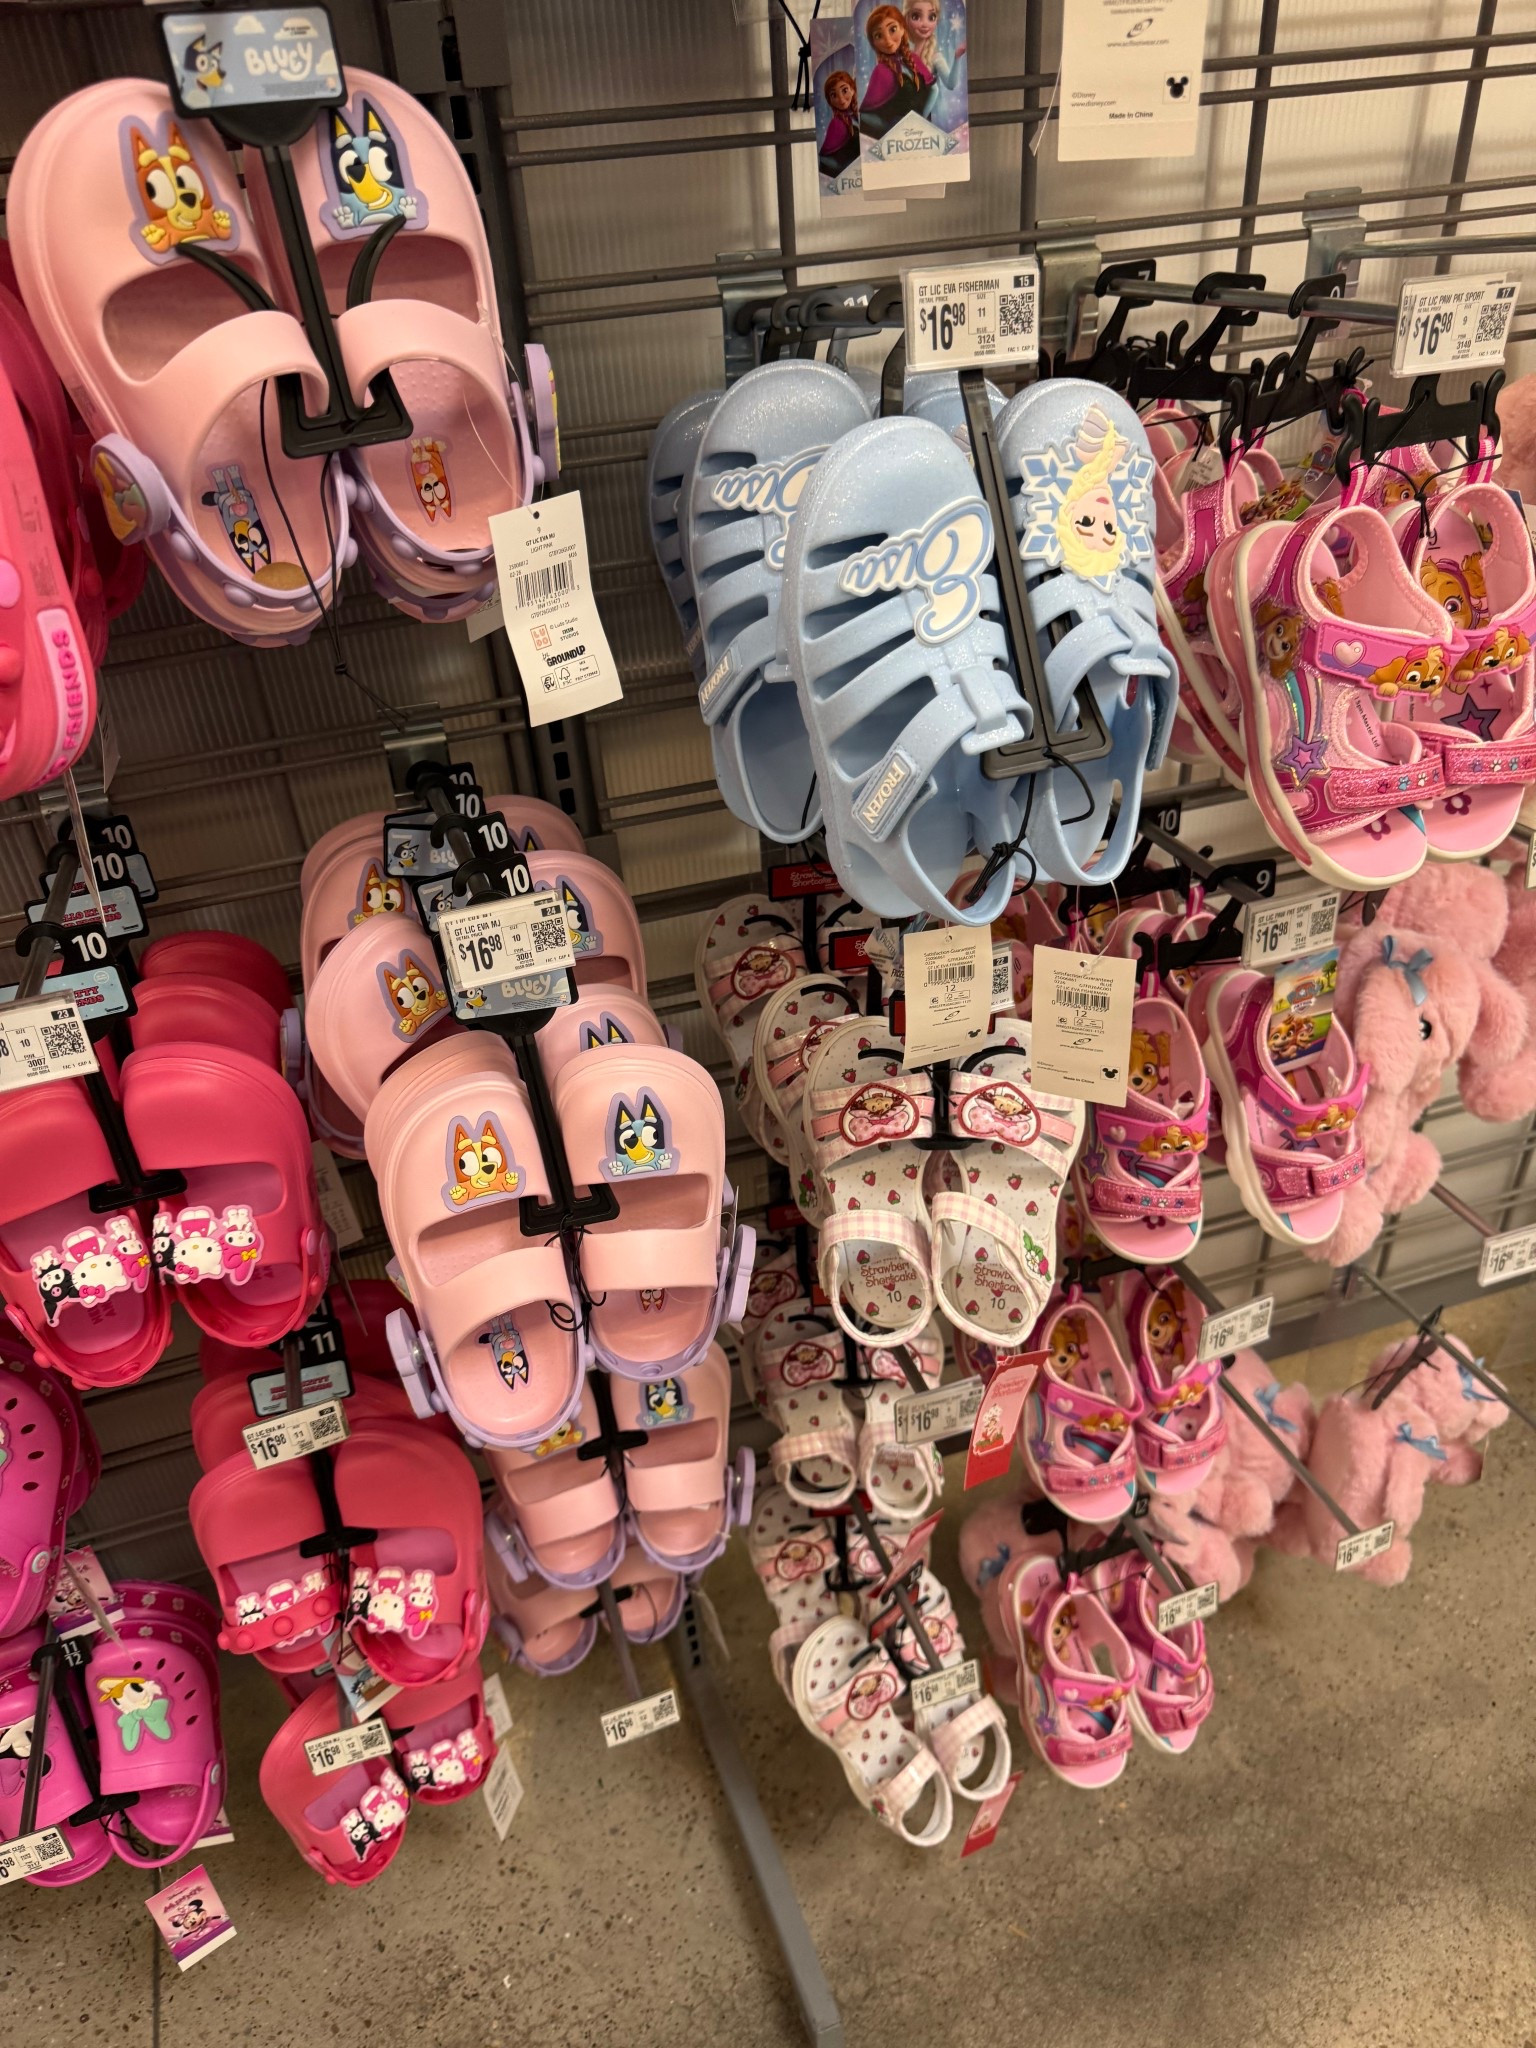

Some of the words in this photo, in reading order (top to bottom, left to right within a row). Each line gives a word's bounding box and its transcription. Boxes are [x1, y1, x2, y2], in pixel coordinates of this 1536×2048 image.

[886, 135, 940, 155] FROZEN
[841, 177, 862, 190] FRO
[919, 286, 927, 296] GT
[930, 285, 941, 295] LIC
[944, 283, 956, 293] EVA
[958, 279, 1000, 293] FISHERMAN
[1019, 276, 1029, 287] 15
[1428, 296, 1438, 306] LIC
[1439, 295, 1452, 304] PAW
[1454, 293, 1464, 303] PAT
[1465, 291, 1485, 302] SPORT
[1502, 288, 1510, 298] 17
[977, 308, 986, 317] 11
[978, 335, 995, 344] 3124
[845, 500, 994, 640] Elsa
[52, 628, 83, 750] FRIENDS
[863, 761, 906, 825] FROZEN
[455, 794, 481, 819] 10
[1158, 809, 1177, 831] 10
[102, 825, 132, 850] 10
[478, 821, 508, 852] 10
[93, 853, 125, 881] 10
[501, 864, 530, 896] 10
[1256, 870, 1270, 893] 9
[546, 907, 556, 916] 24
[454, 928, 463, 937] GT
[465, 926, 475, 934] LIC
[477, 923, 490, 932] EVA
[491, 920, 501, 929] MJ
[512, 934, 521, 942] 10
[72, 932, 108, 962] 10
[515, 953, 533, 961] 3001
[502, 975, 551, 1000] BLUEY
[58, 1009, 69, 1019] 23
[1076, 1010, 1087, 1018] 12
[20, 1039, 31, 1048] 10
[28, 1058, 46, 1068] 3007
[887, 1291, 902, 1303] 10
[990, 1297, 1005, 1310] 10
[311, 1331, 336, 1355] 11
[61, 1641, 76, 1654] 11
[65, 1653, 83, 1668] 12
